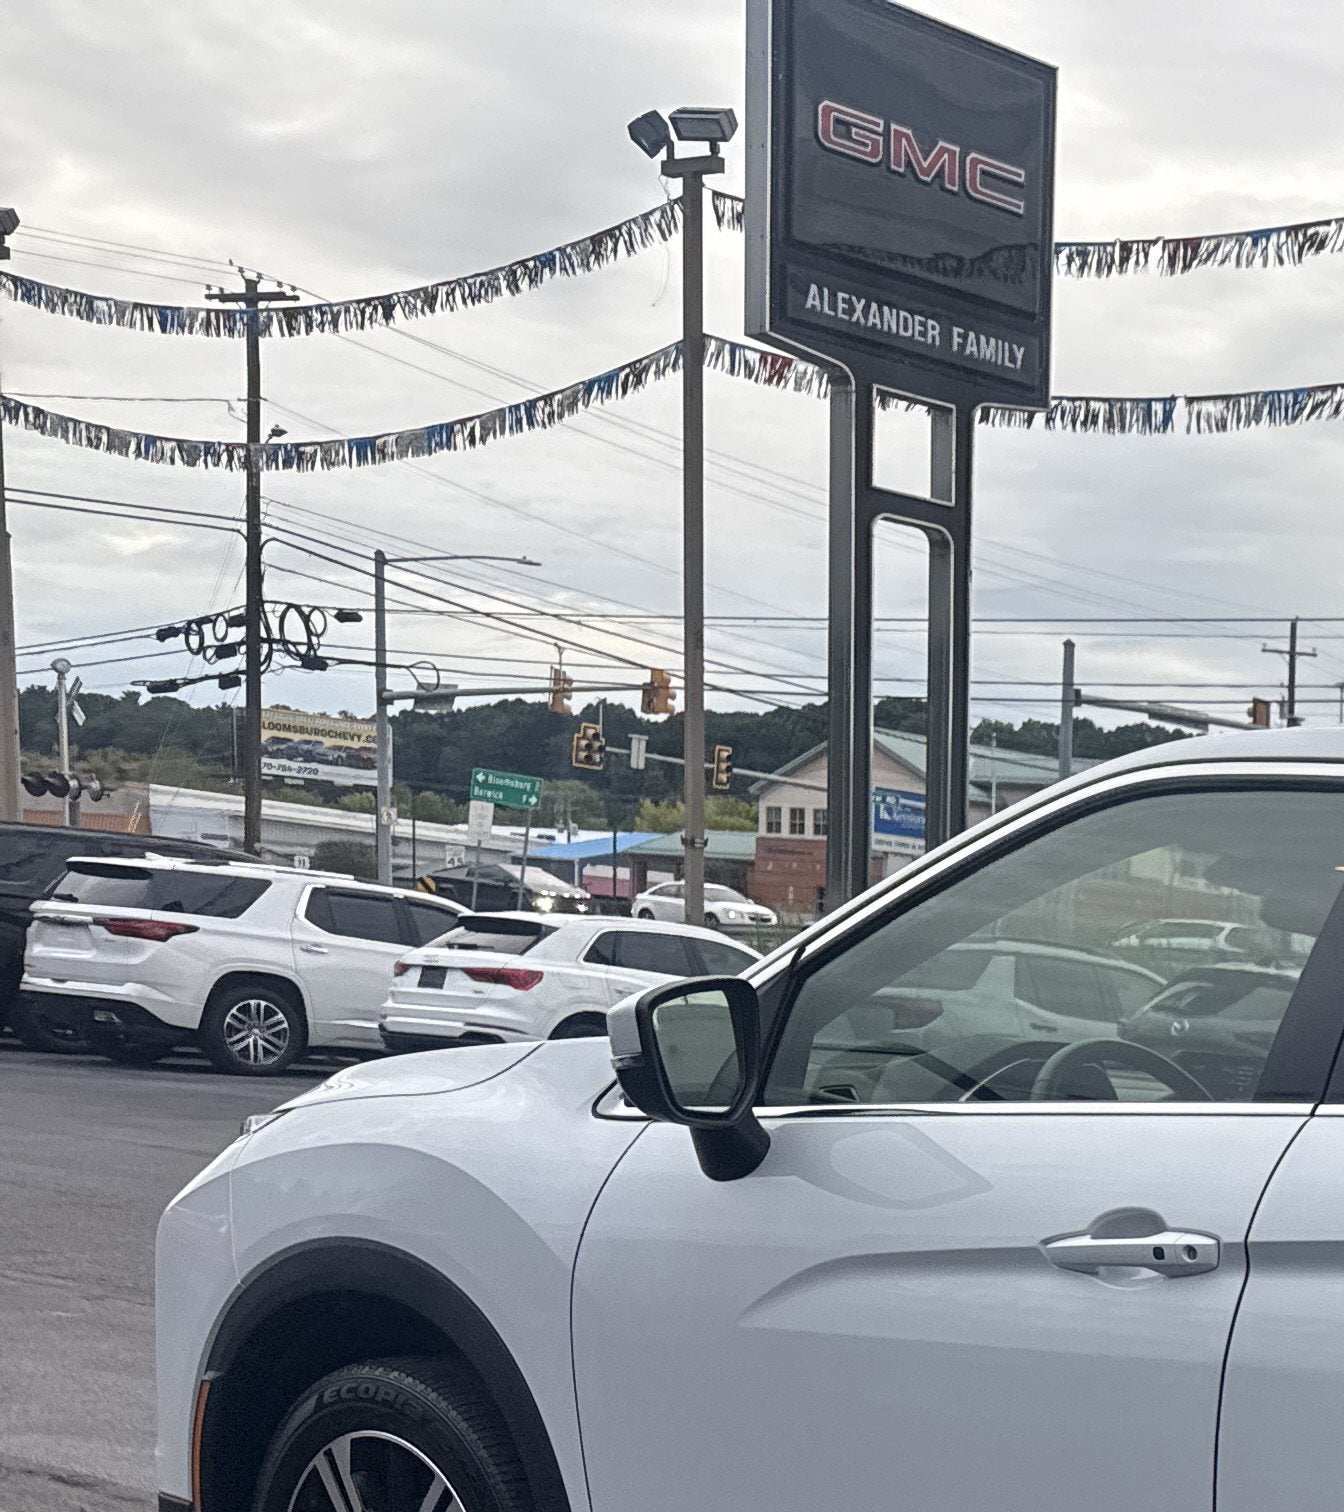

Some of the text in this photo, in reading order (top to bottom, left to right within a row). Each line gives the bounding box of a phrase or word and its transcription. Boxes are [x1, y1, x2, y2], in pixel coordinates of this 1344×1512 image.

[817, 99, 1026, 216] GMC
[805, 283, 1026, 370] ALEXANDER FAMILY
